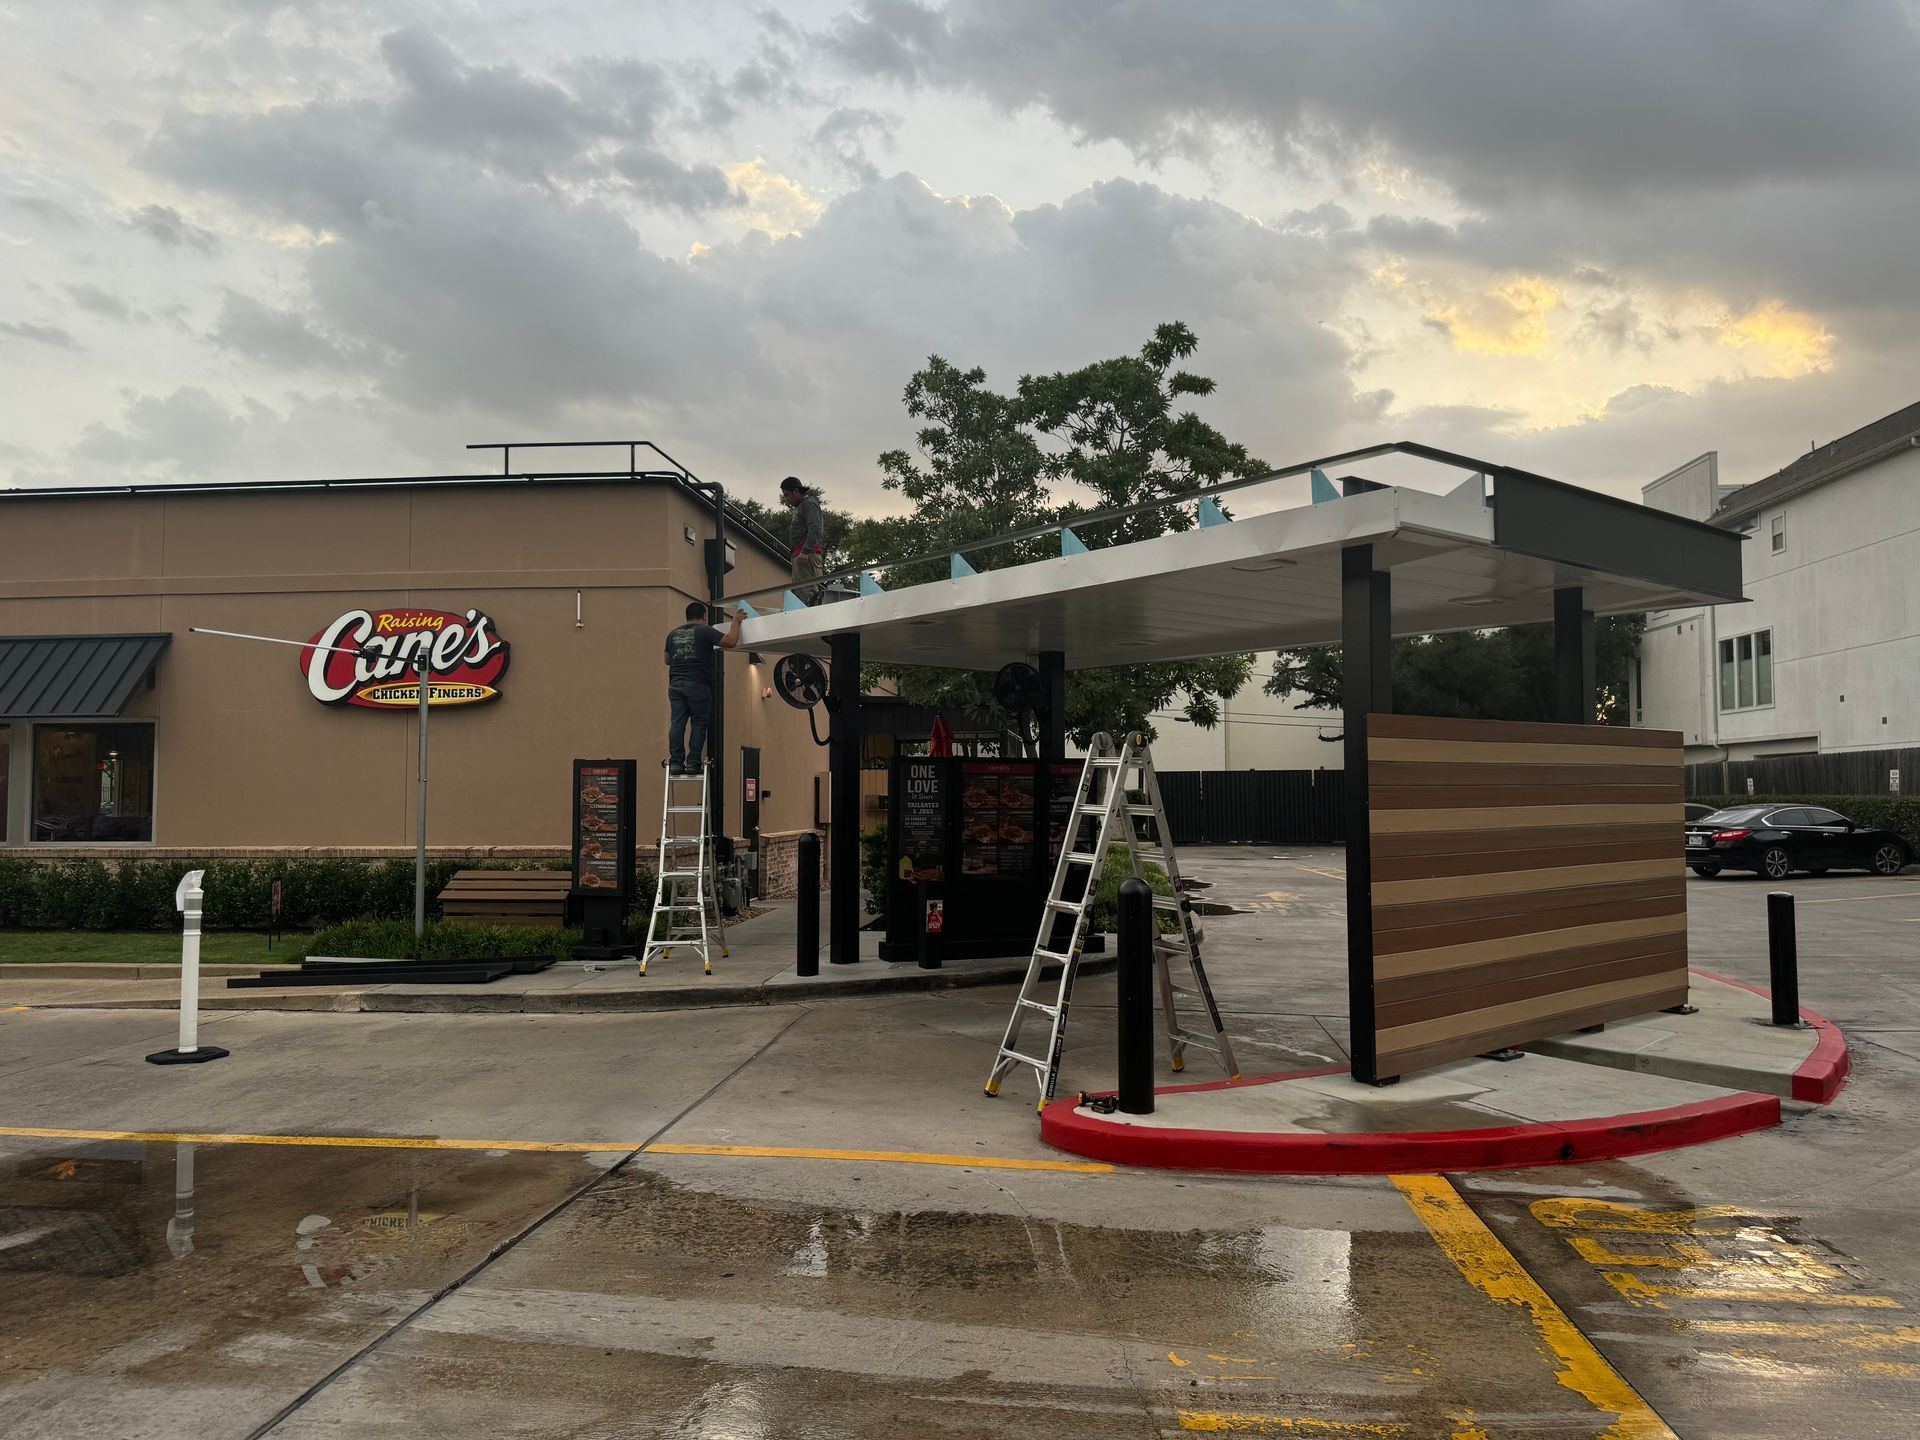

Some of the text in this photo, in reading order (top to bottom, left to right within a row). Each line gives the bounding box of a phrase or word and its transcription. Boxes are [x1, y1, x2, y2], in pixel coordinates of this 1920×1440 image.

[377, 612, 444, 632] Raising
[308, 609, 502, 702] Cane's
[373, 687, 483, 700] CHICKE FINGERS
[910, 765, 936, 779] ONE
[908, 780, 939, 793] LOVE
